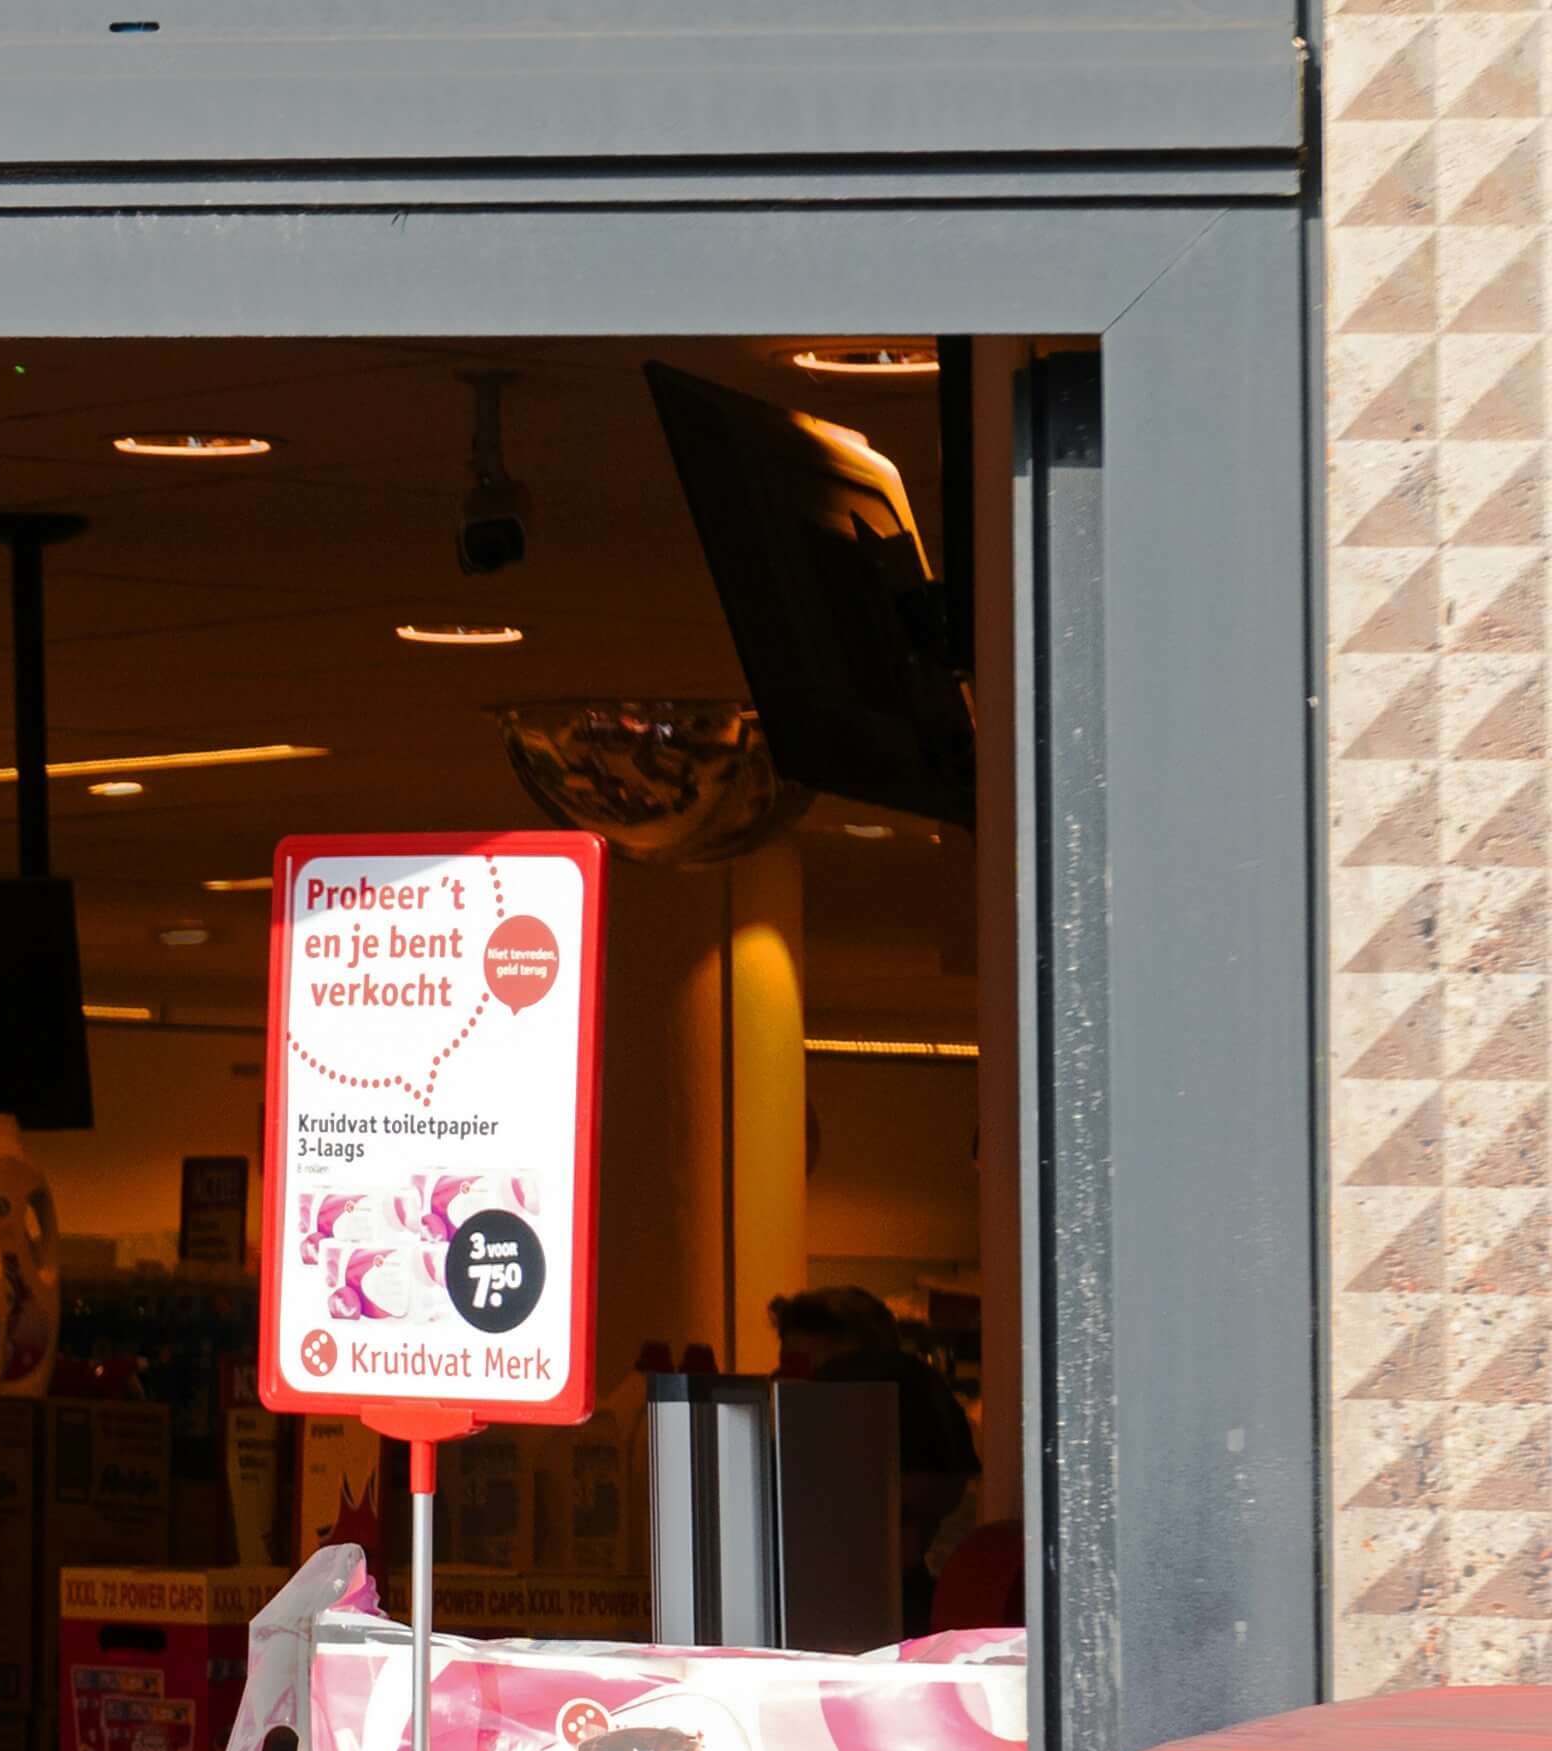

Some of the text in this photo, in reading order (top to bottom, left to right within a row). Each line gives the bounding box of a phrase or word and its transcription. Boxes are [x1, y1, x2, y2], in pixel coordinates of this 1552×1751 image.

[307, 876, 430, 911] Probeer
[305, 923, 463, 968] en je bent
[488, 948, 508, 960] Niet
[311, 973, 452, 1008] verkocht
[298, 1113, 498, 1139] Kruidvat toiletpapier
[298, 1138, 364, 1162] 3-laags
[469, 1232, 518, 1259] 3 VOOR
[352, 1342, 551, 1380] Kruidvat Merk
[102, 1582, 117, 1607] 72
[119, 1582, 166, 1610] POWER
[170, 1585, 204, 1611] CAPS
